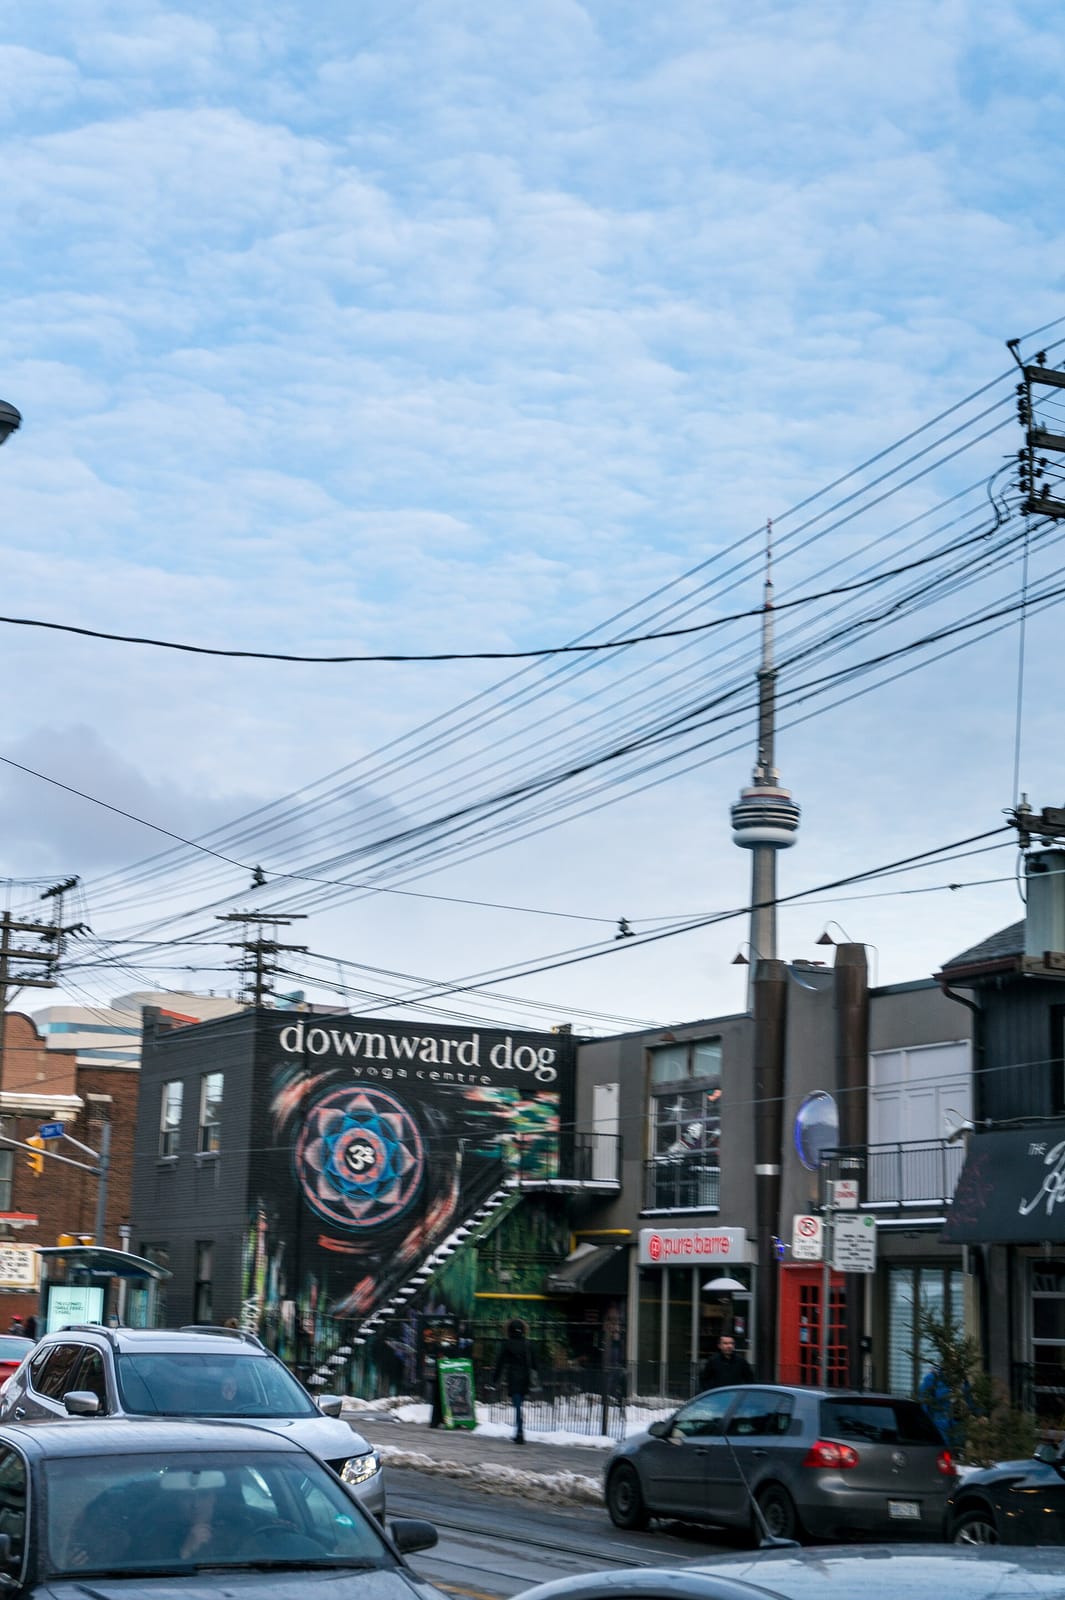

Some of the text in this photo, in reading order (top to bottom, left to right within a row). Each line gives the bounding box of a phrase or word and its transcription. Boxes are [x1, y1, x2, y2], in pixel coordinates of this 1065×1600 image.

[279, 1020, 558, 1082] downward dog
[353, 1066, 492, 1085] yoga centre
[663, 1237, 692, 1260] pure
[694, 1233, 729, 1254] barre
